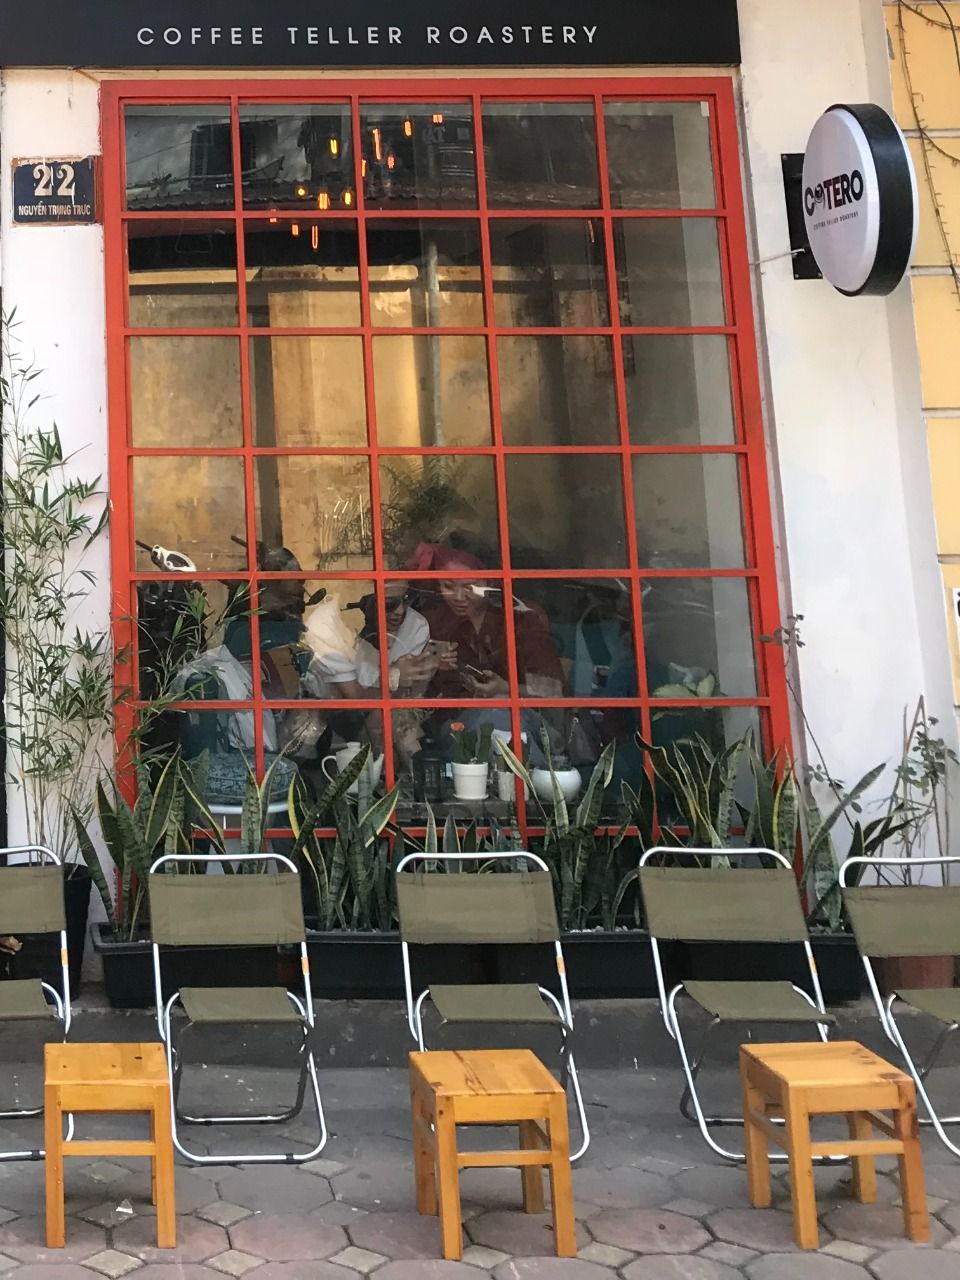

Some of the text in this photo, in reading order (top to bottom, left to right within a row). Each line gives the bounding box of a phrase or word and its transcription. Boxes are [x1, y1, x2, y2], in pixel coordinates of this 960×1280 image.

[137, 26, 598, 45] COFFEE TELLER ROASTERY
[33, 164, 75, 196] 22
[48, 204, 71, 216] TRUNG
